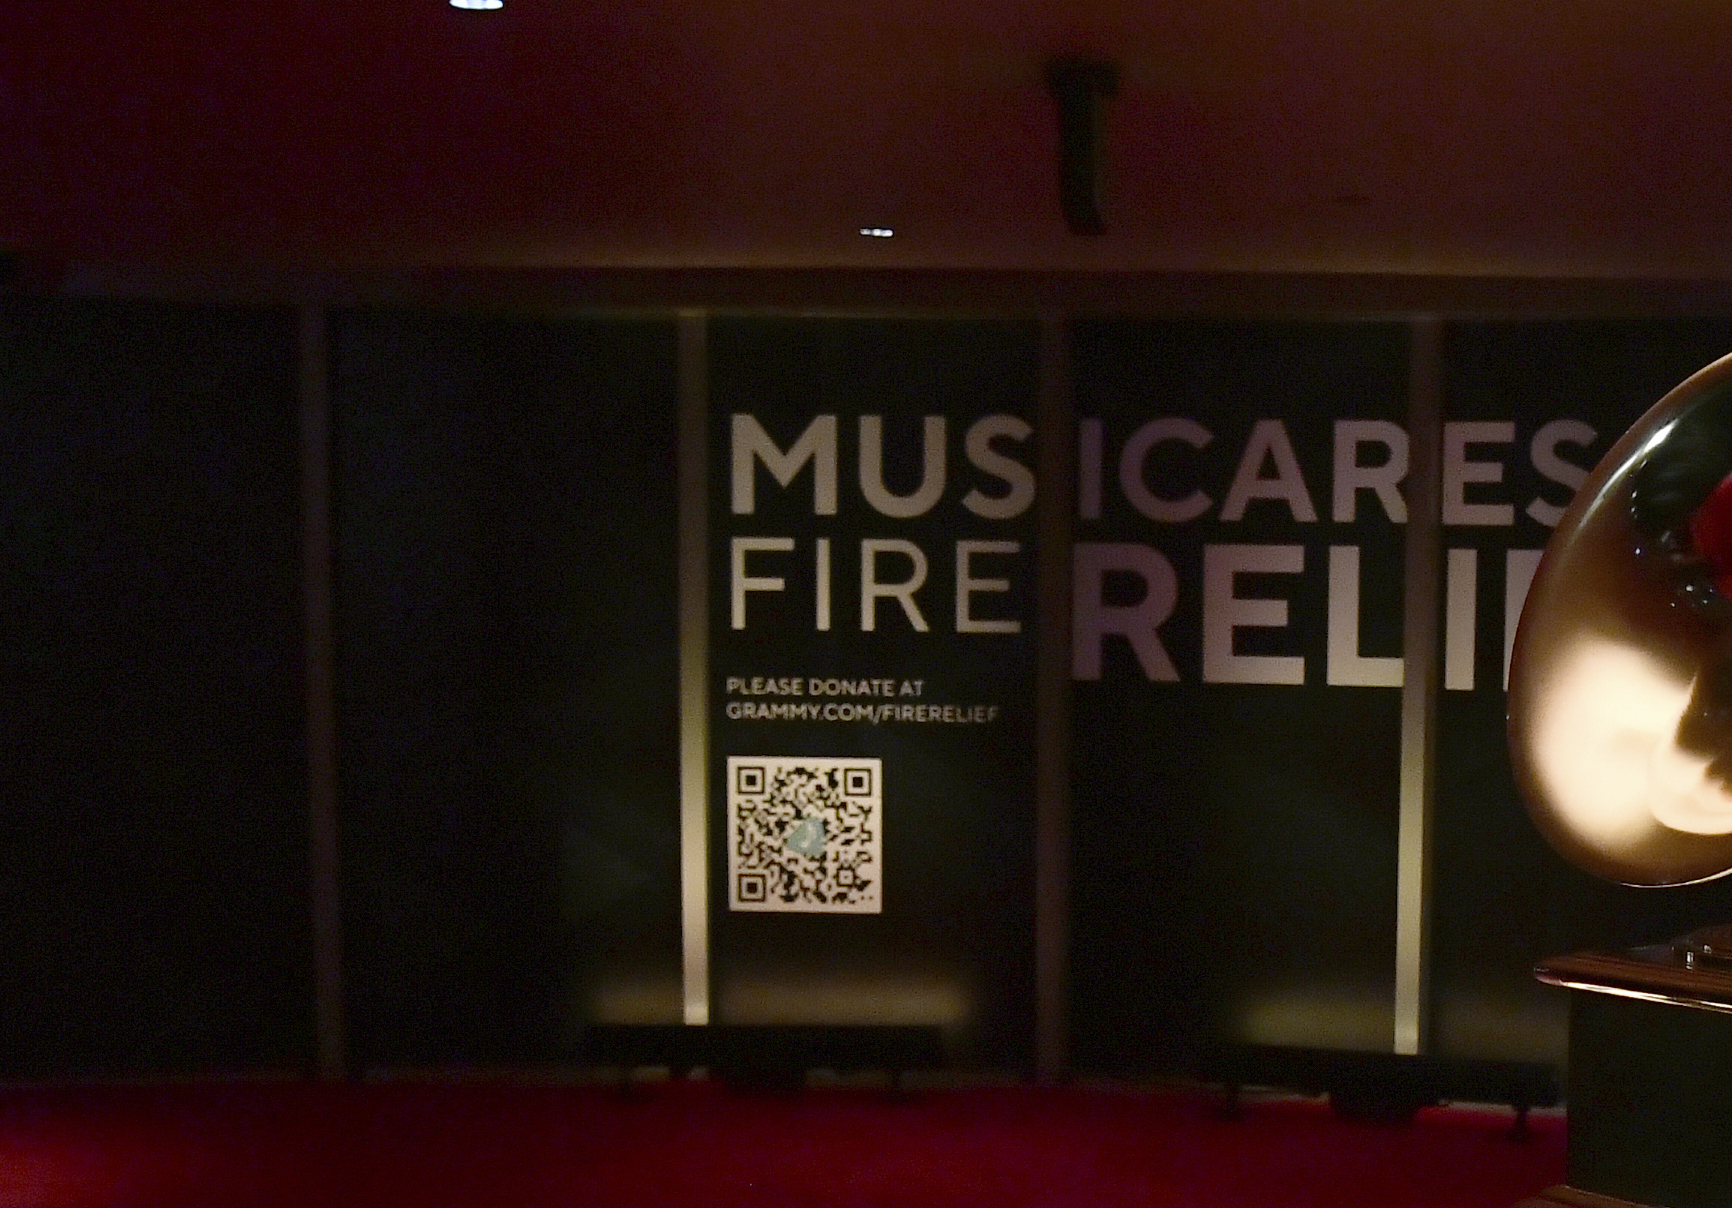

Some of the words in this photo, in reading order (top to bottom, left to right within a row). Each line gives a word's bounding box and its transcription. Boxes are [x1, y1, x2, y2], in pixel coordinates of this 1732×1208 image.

[731, 413, 1598, 527] MUSICARES
[731, 536, 1023, 634] FIRE
[1071, 541, 1545, 692] RELI
[725, 676, 804, 697] PLEASE
[808, 677, 896, 698] DONATE
[899, 678, 925, 698] AT
[725, 702, 999, 726] GRAMMY.COM/FIRERELIEF
